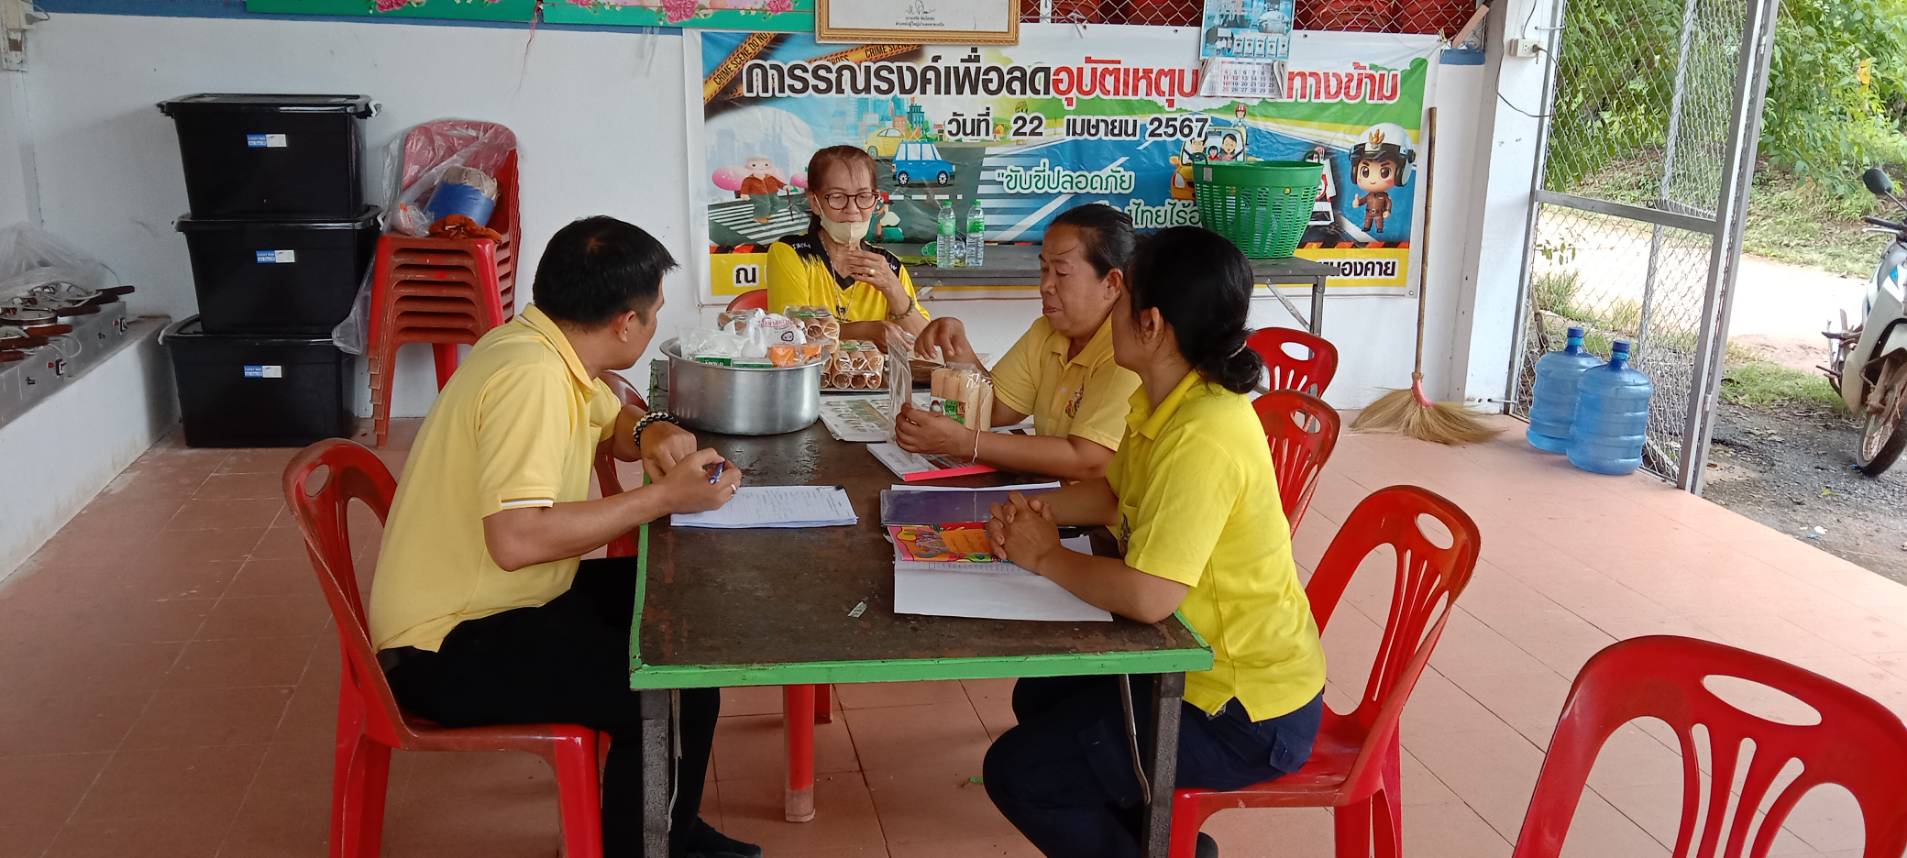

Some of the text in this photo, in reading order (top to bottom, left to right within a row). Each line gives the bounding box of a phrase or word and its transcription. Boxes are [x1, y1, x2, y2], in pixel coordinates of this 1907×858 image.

[713, 64, 732, 85] CRIME
[731, 47, 752, 68] SCENE
[947, 106, 1209, 138] วันที่ 22 เมษายน 2567
[735, 266, 757, 284] ณ
